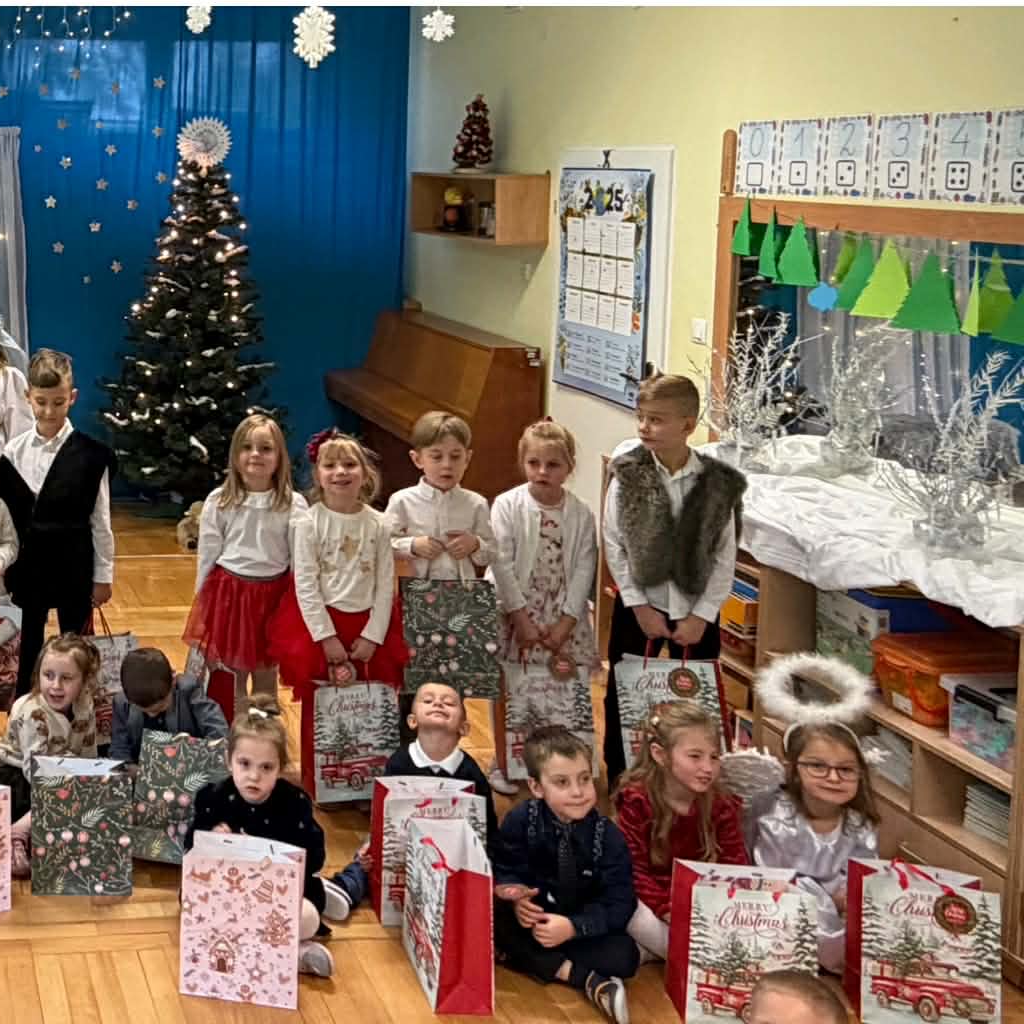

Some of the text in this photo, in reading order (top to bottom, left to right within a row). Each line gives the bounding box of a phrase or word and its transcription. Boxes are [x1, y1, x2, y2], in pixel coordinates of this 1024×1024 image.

[794, 127, 806, 159] 1
[839, 122, 856, 157] 2
[889, 121, 912, 157] 3
[950, 119, 970, 158] 4
[716, 906, 788, 932] Christmas
